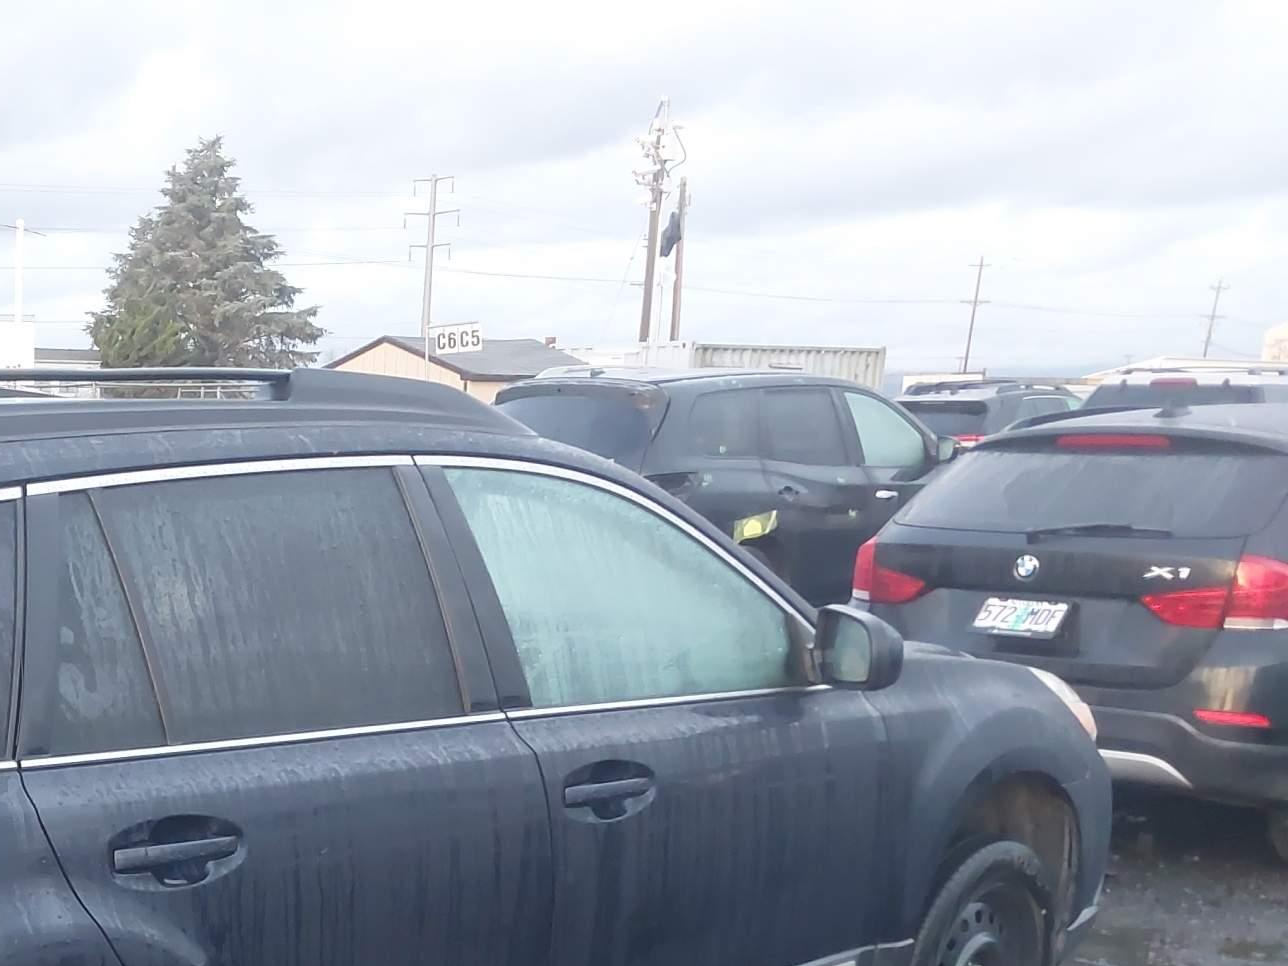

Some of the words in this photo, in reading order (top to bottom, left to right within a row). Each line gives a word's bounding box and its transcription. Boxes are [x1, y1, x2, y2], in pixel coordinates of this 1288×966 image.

[437, 331, 457, 350] C6
[460, 329, 481, 348] C5
[1142, 566, 1191, 580] X1
[975, 604, 1018, 623] 572
